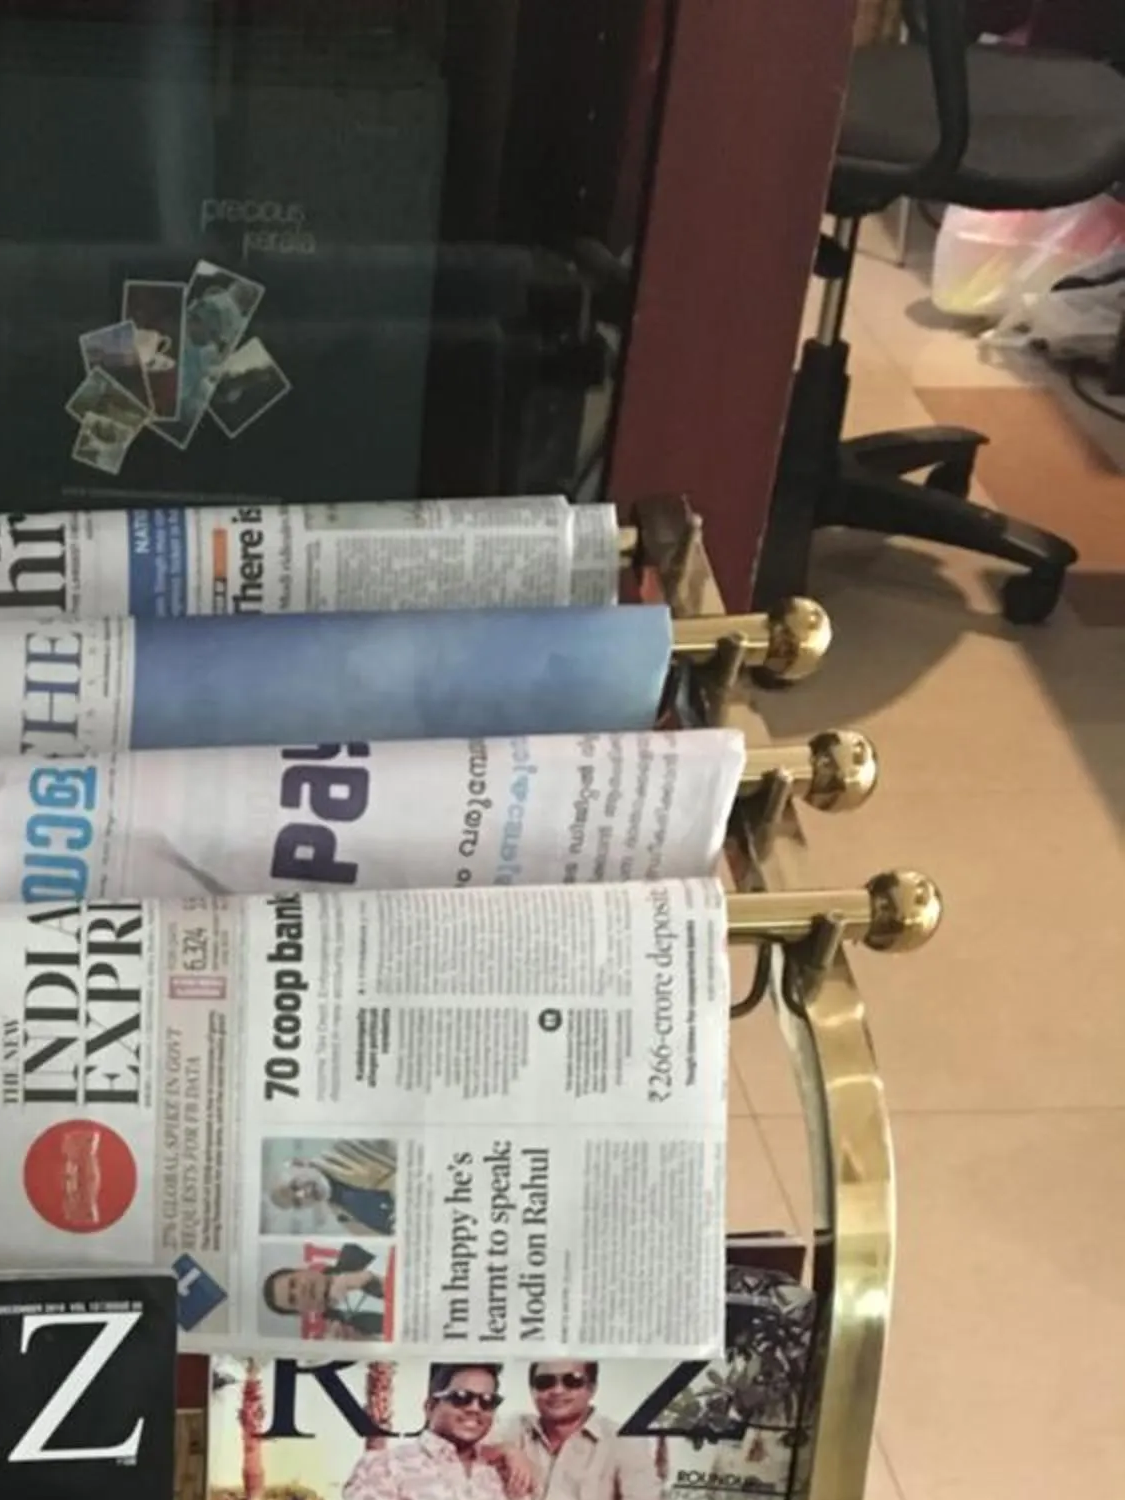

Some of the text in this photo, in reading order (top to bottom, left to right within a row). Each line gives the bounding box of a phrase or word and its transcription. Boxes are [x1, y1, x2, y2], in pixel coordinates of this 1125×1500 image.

[20, 632, 82, 754] HE
[1, 1018, 20, 1105] THE NEW
[23, 903, 81, 1105] INDIA
[263, 891, 309, 1101] 70 coop bank
[441, 1209, 478, 1292] happy
[478, 1140, 516, 1342] learnt to speak:
[517, 1147, 549, 1342] Modi on Rahul
